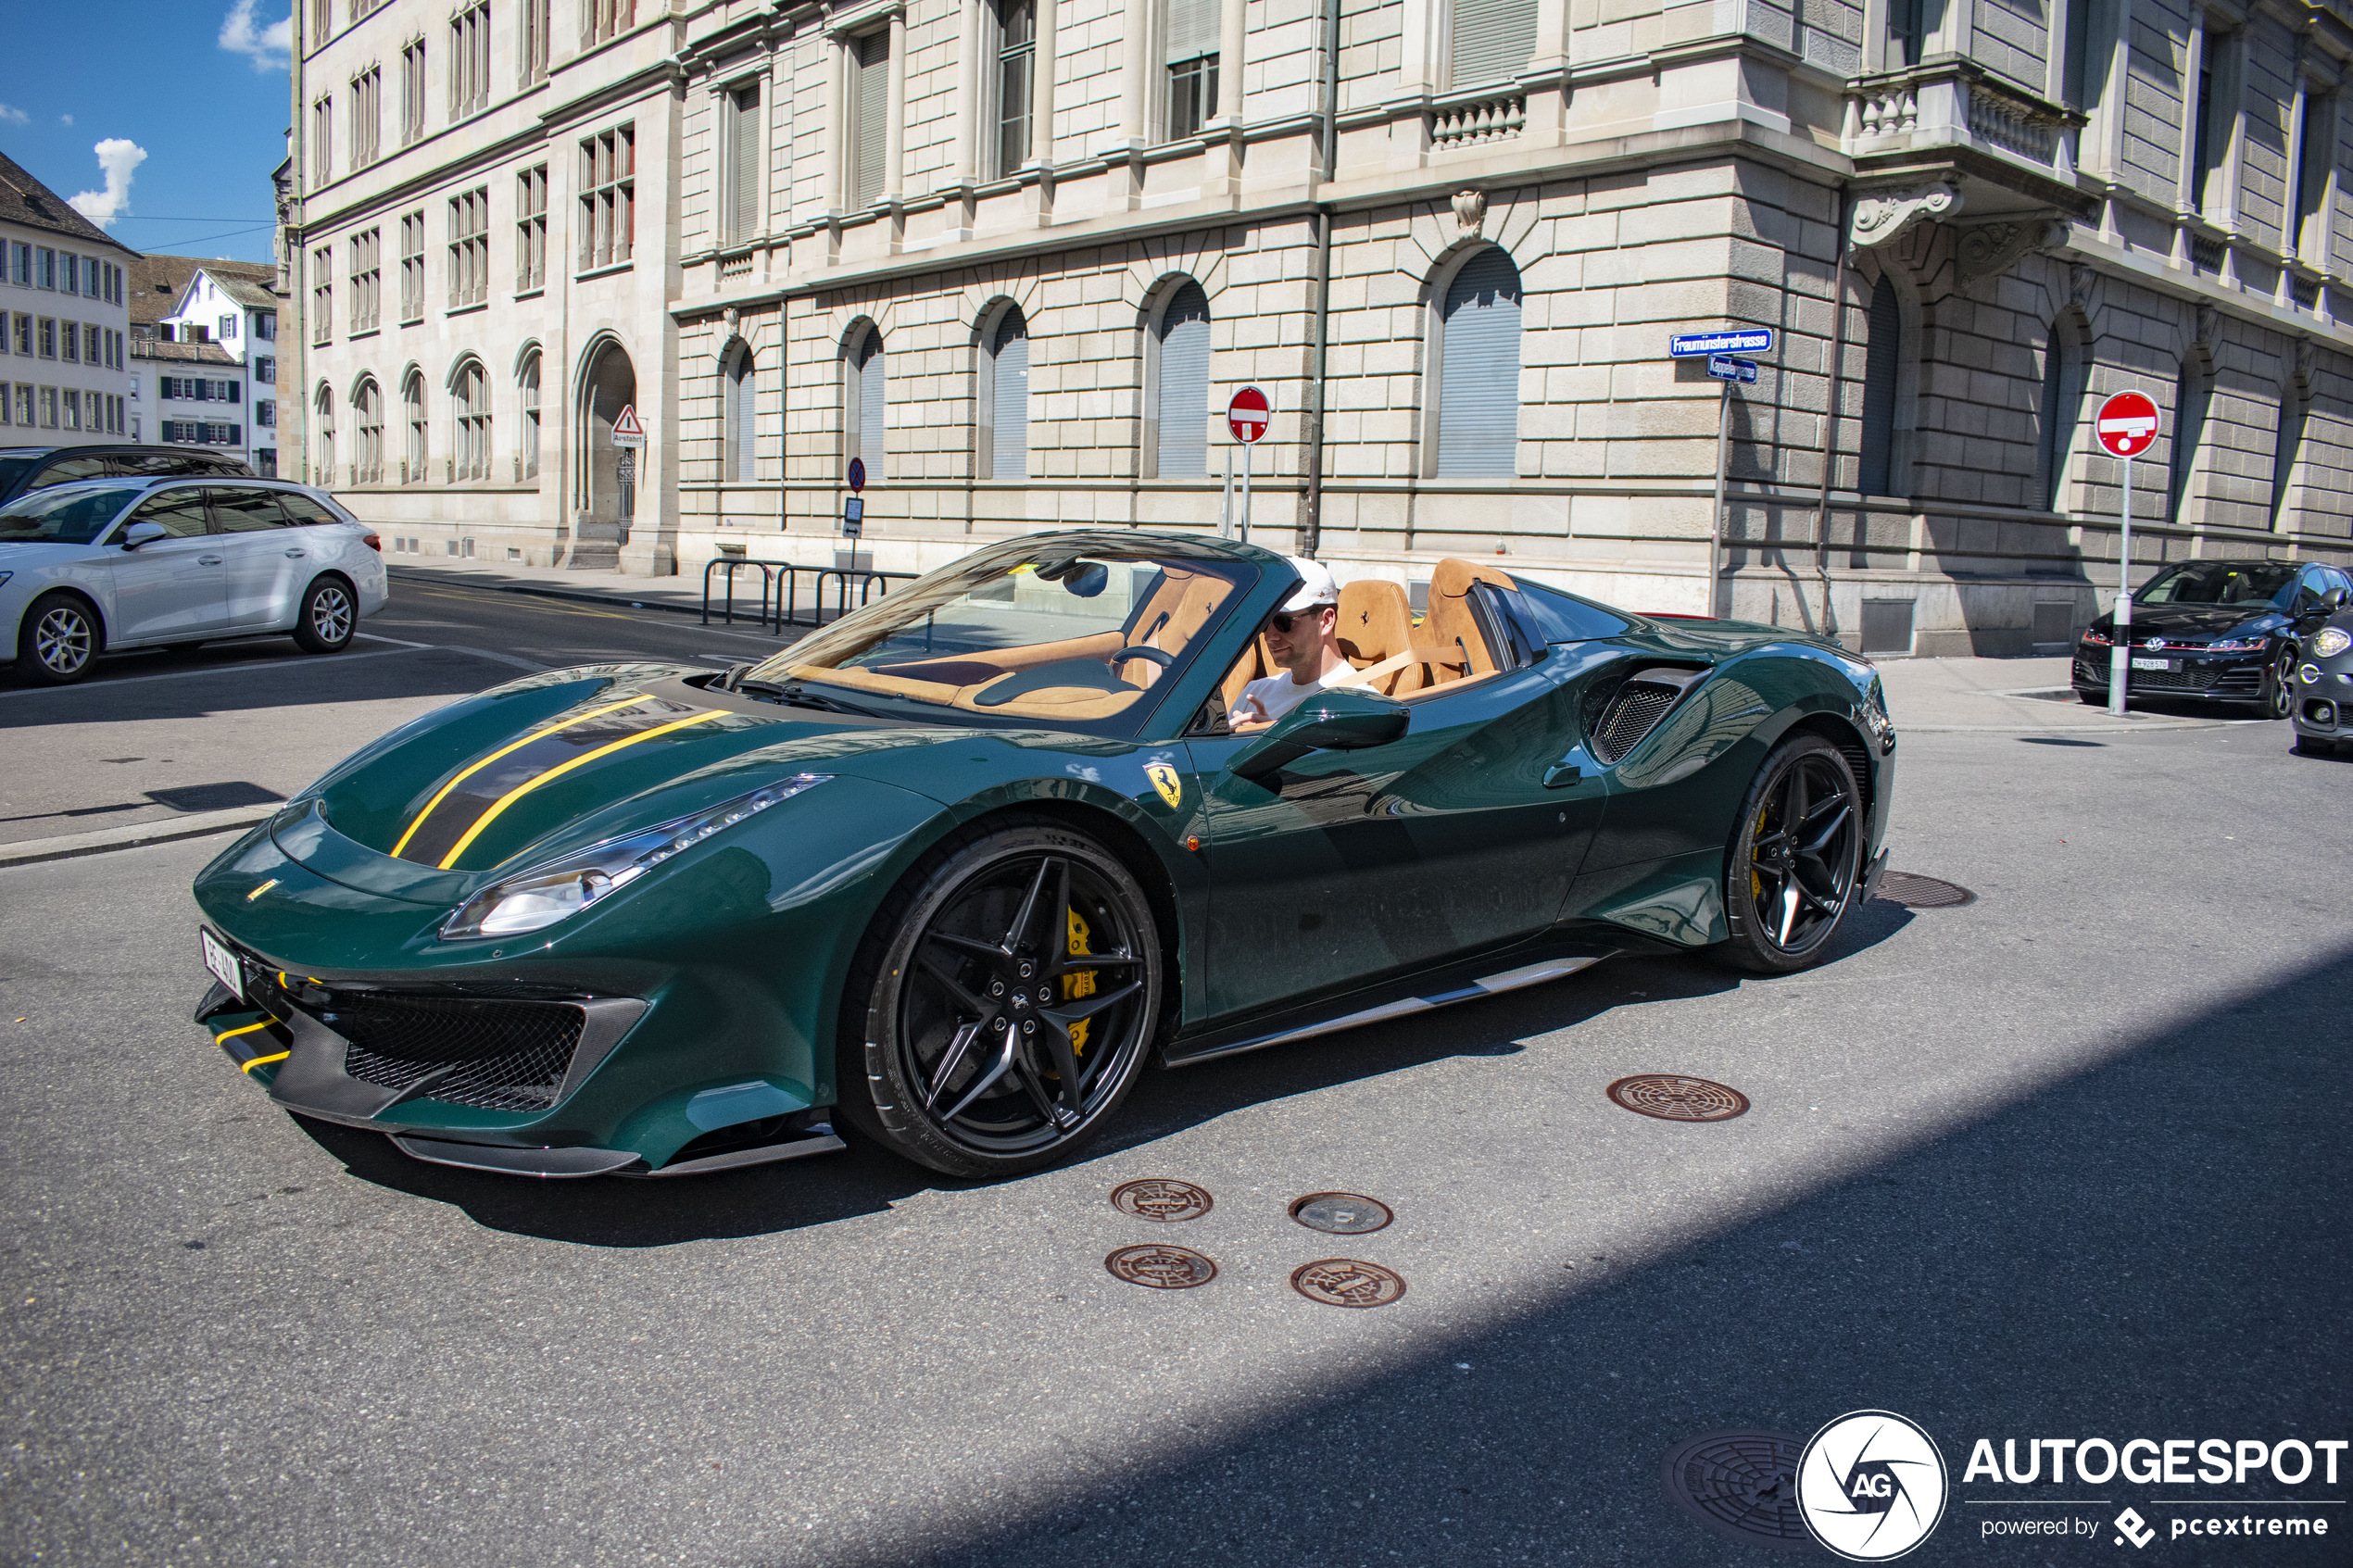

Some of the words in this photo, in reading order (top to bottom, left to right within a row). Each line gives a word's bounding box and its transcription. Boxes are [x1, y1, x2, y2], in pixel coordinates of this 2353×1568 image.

[1672, 334, 1768, 353] Fraumünsterstrasse
[1709, 357, 1755, 380] Kappelergasse
[614, 434, 642, 443] Ausfahrt
